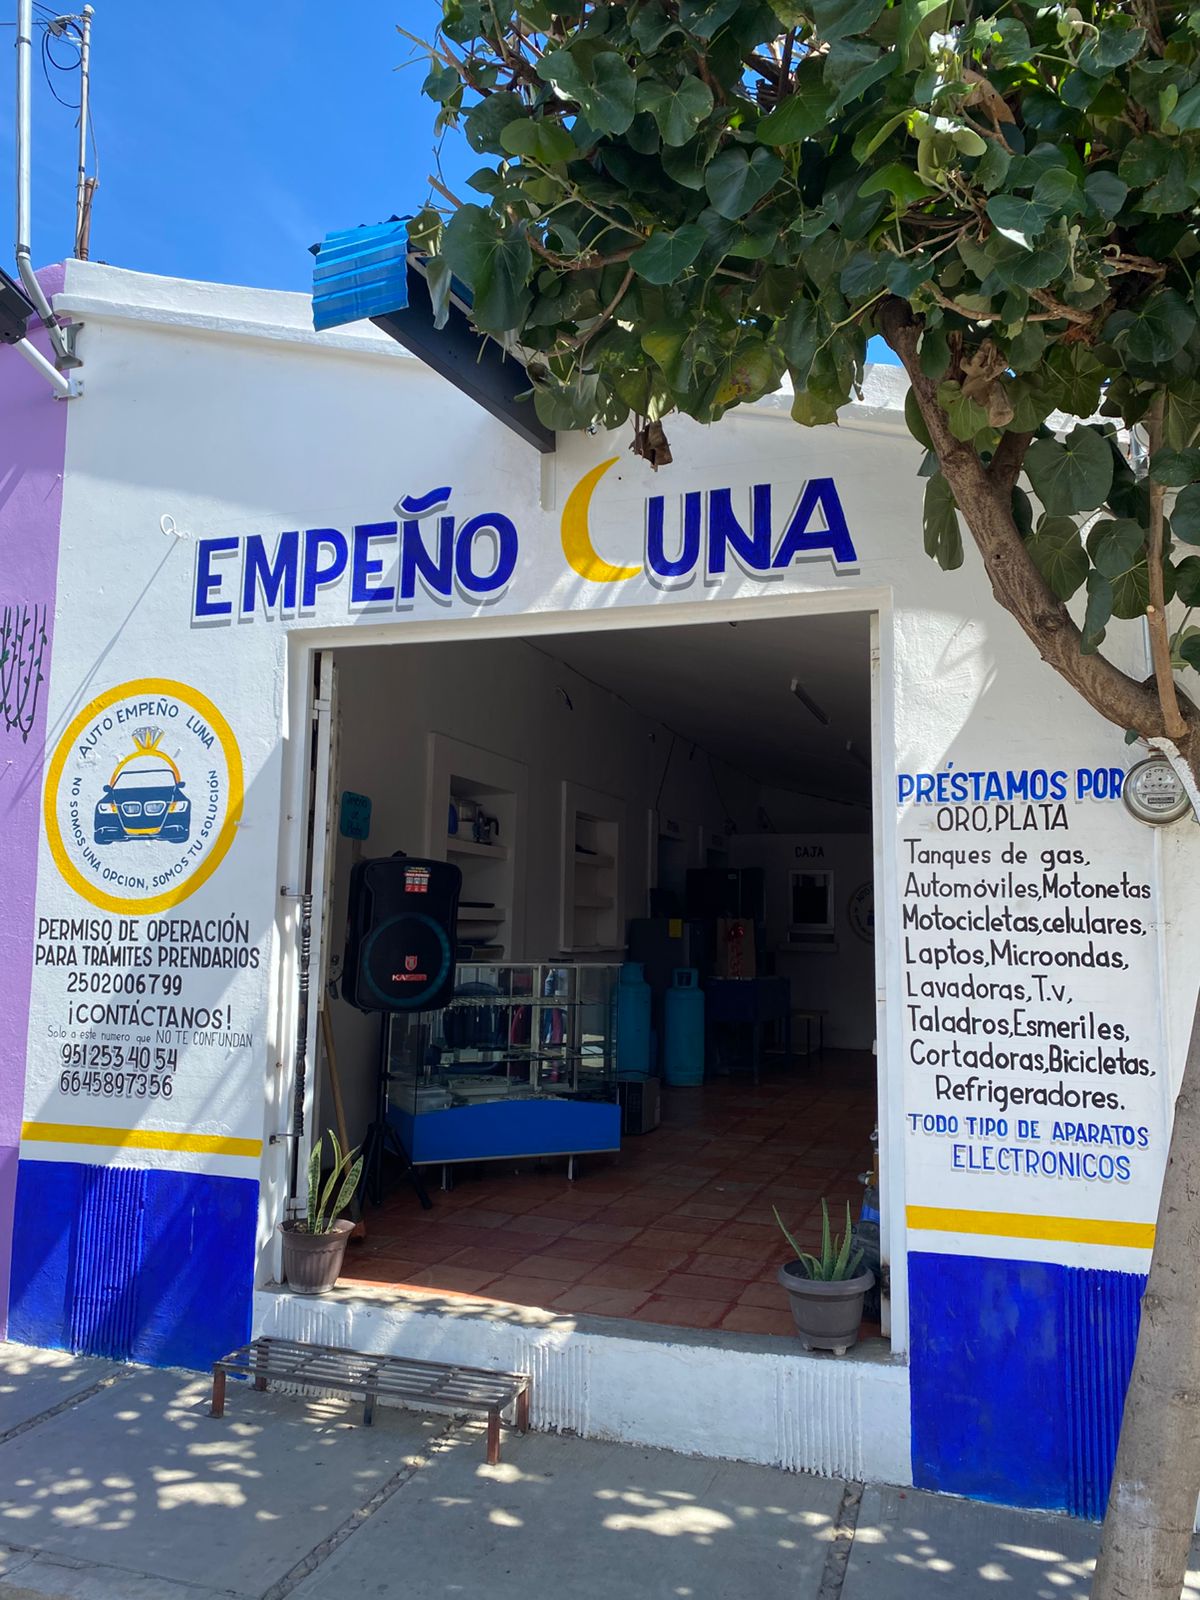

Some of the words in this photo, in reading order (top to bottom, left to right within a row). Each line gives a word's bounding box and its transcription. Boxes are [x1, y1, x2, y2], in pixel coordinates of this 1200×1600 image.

[194, 486, 519, 618] EMPEÑO
[79, 717, 113, 759] AUTO
[116, 698, 179, 724] EMPEÑO
[186, 715, 215, 750] LUNA
[72, 777, 82, 796] NO
[898, 762, 1068, 803] PRÉSTAMOS
[1077, 768, 1125, 799] POR
[200, 769, 219, 838] SOLUCIÓN
[69, 801, 86, 847] SOMOS
[83, 846, 102, 872] UNA
[188, 839, 204, 857] TU
[795, 846, 825, 858] CAJA
[903, 838, 991, 869] Tanques
[1001, 842, 1028, 864] de
[1040, 849, 1091, 872] gas,
[102, 868, 149, 890] OPCION,
[152, 858, 189, 888] SOMOS
[38, 917, 112, 942] PERMISO
[118, 920, 139, 942] DE
[146, 912, 250, 943] OPERACIÓN
[35, 945, 77, 966] PARA
[82, 941, 153, 967] TRÁMITES
[158, 946, 260, 969] PRENDARIOS
[66, 972, 183, 996] 2502006799
[68, 999, 232, 1030] ¡CONTÁCTANOS!
[47, 1025, 67, 1039] Solo
[70, 1031, 77, 1039] a
[79, 1029, 97, 1040] este
[100, 1031, 131, 1042] numero
[136, 1034, 151, 1045] que
[156, 1030, 172, 1044] NO
[175, 1030, 189, 1045] TE
[192, 1031, 253, 1048] CONFUNDAN
[60, 1070, 173, 1098] 6645897356
[935, 1074, 1125, 1112] Refrigeradores.
[907, 1113, 959, 1134] TODO
[966, 1116, 1009, 1137] TIPO
[1018, 1119, 1041, 1139] DE
[1053, 1121, 1150, 1147] APARATOS
[953, 1144, 1131, 1181] ELECTRONICOS
